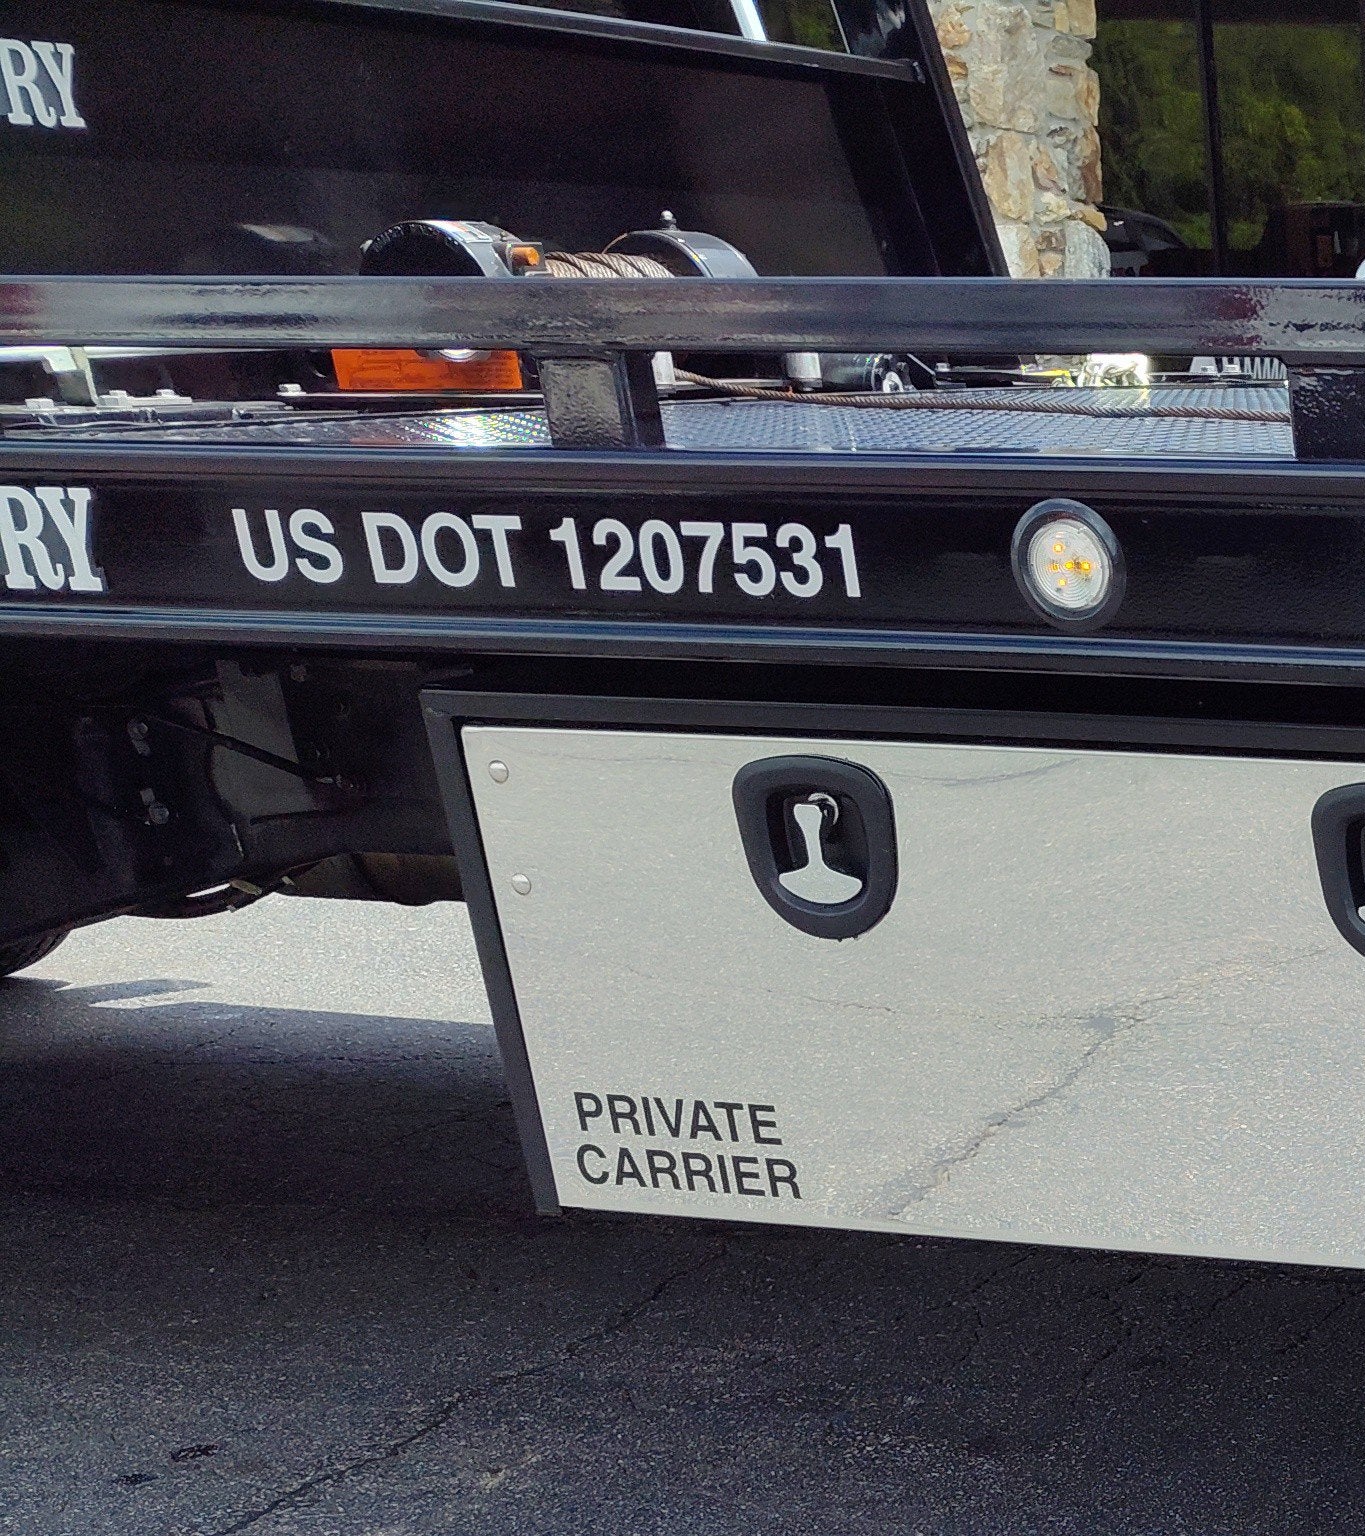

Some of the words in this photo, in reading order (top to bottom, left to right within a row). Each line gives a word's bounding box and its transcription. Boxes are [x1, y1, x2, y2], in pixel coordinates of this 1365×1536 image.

[231, 507, 345, 584] US
[360, 511, 523, 588] DOT
[549, 516, 863, 599] 1207531
[574, 1091, 783, 1146] PRIVATE
[576, 1143, 803, 1200] CARRIER
